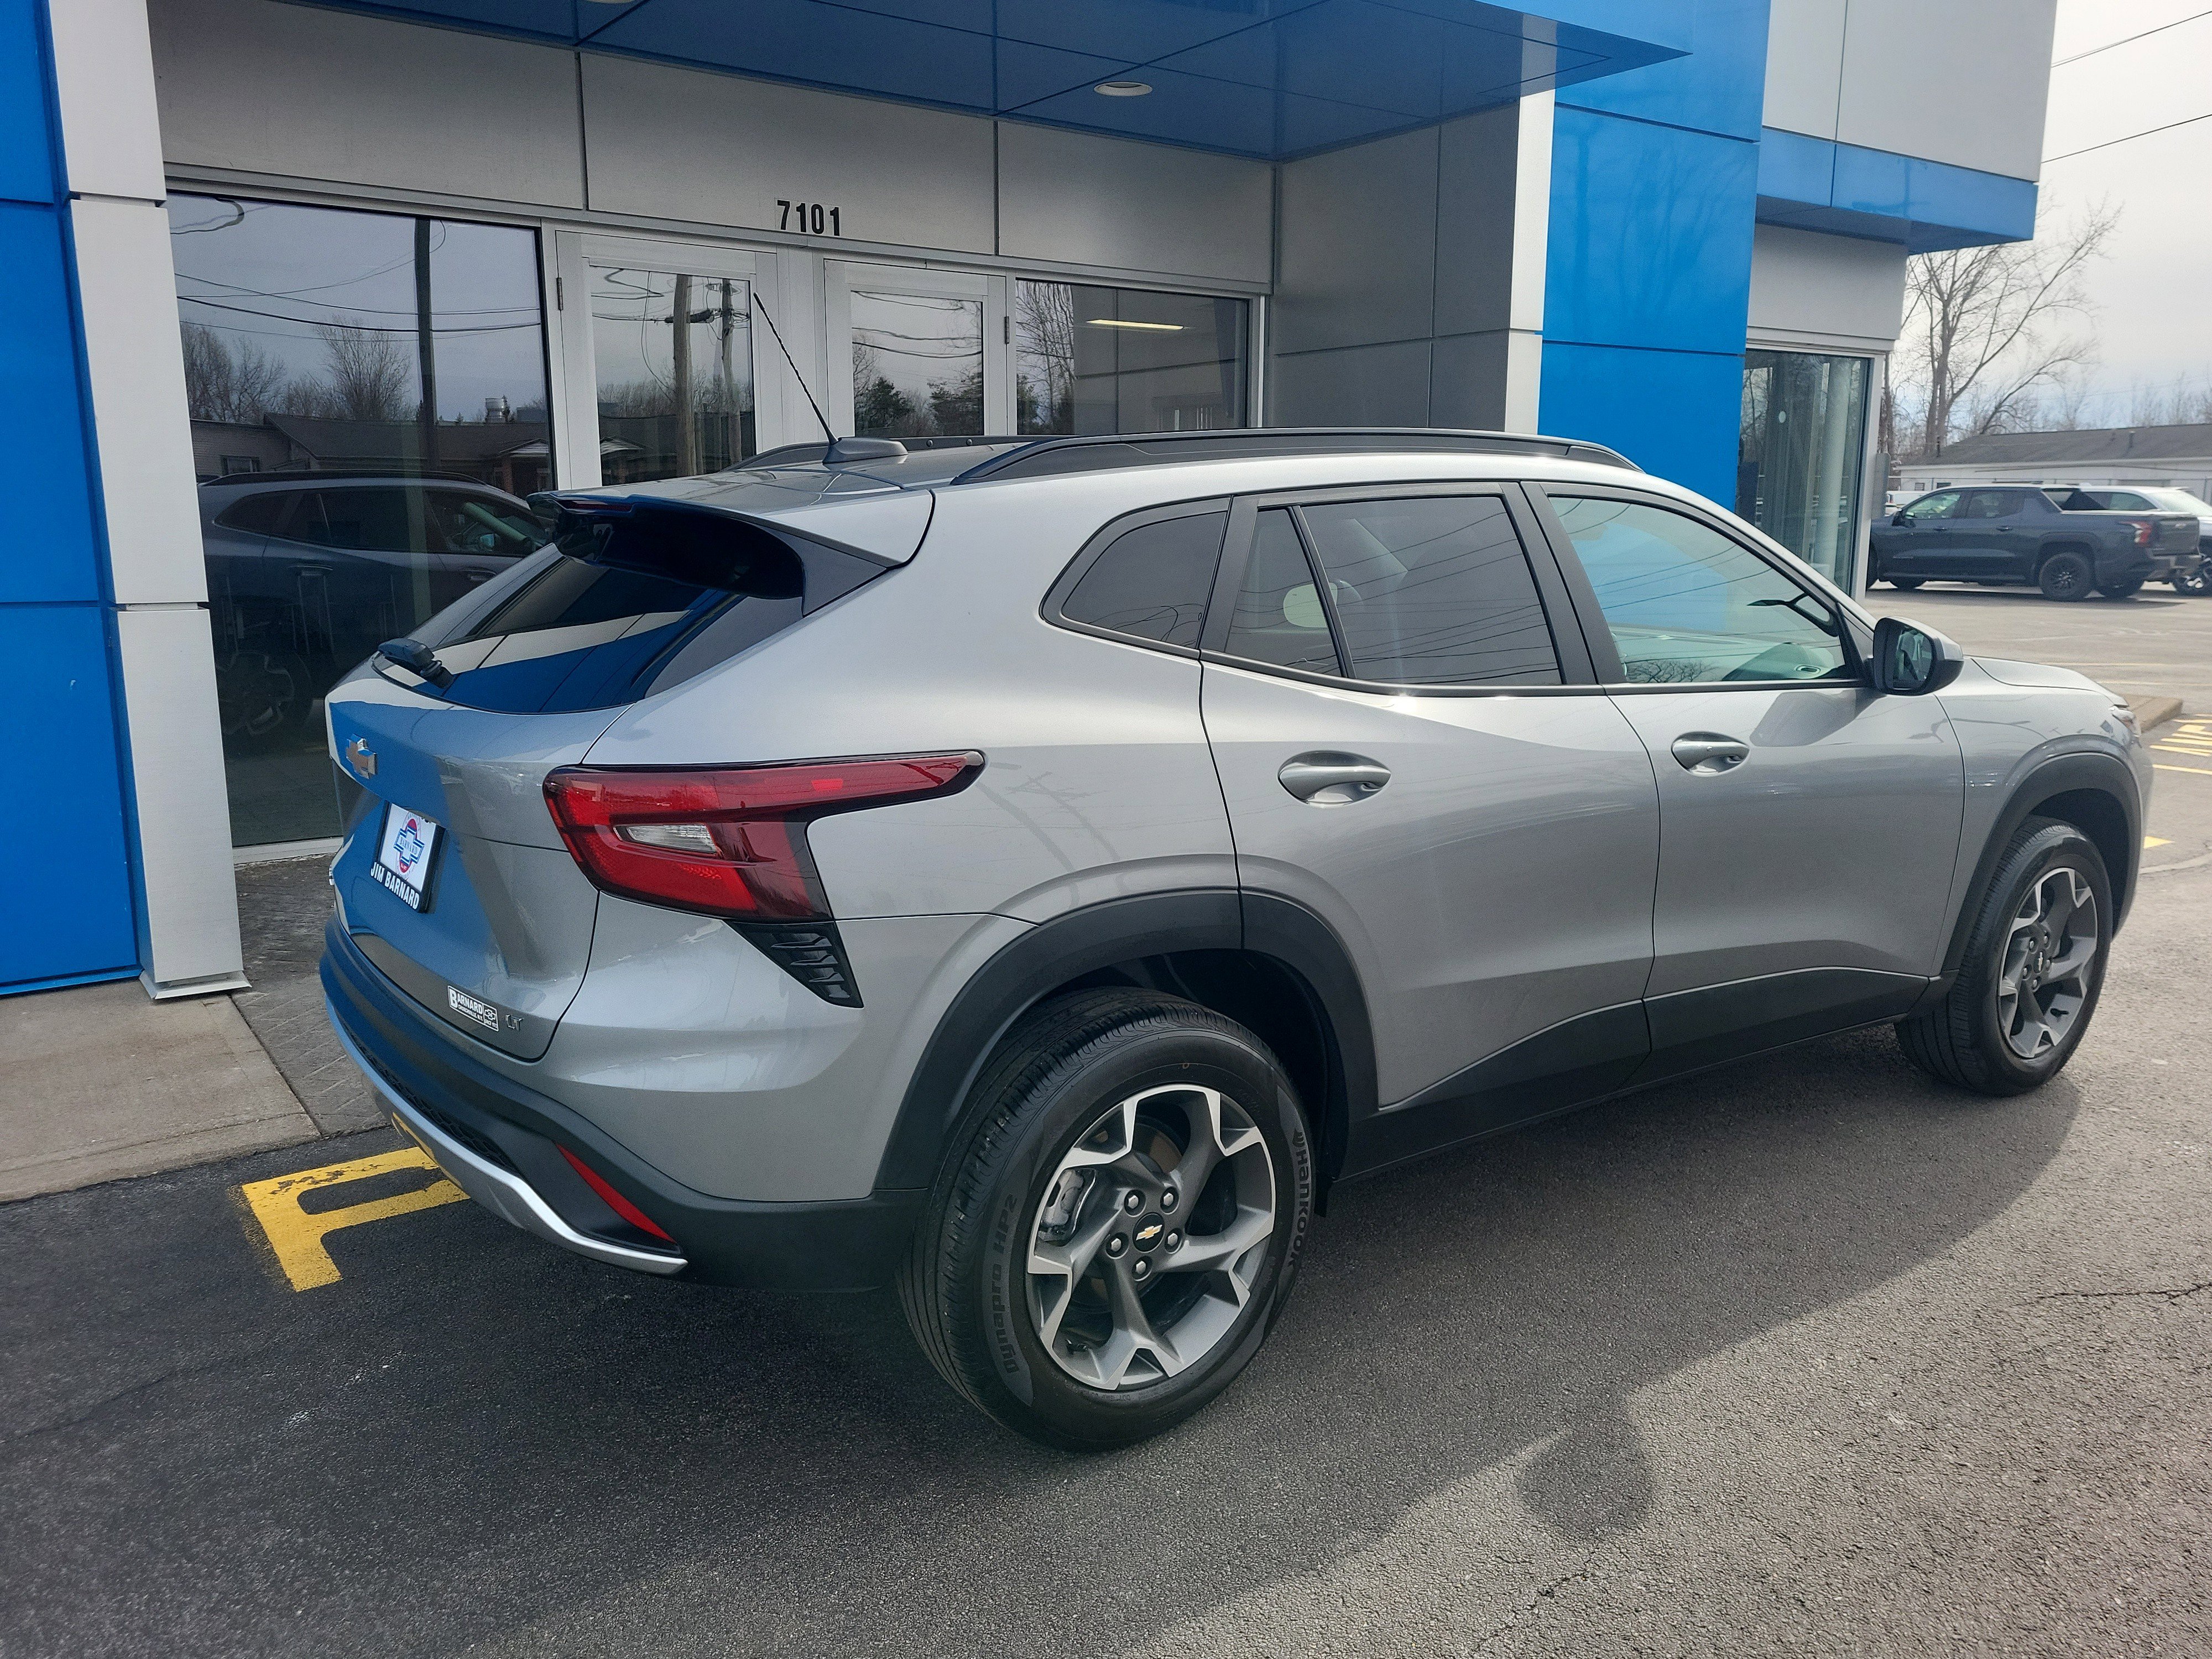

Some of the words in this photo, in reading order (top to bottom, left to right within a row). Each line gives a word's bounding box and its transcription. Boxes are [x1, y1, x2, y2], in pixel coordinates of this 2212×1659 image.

[777, 200, 840, 236] 7101
[399, 837, 418, 855] BARNARD
[371, 862, 385, 883] JIM
[384, 870, 420, 910] BARNARD
[449, 988, 483, 1014] BARNARD
[505, 1014, 524, 1031] LT
[992, 1193, 1018, 1254] HP2
[992, 1263, 1020, 1374] Dynapro
